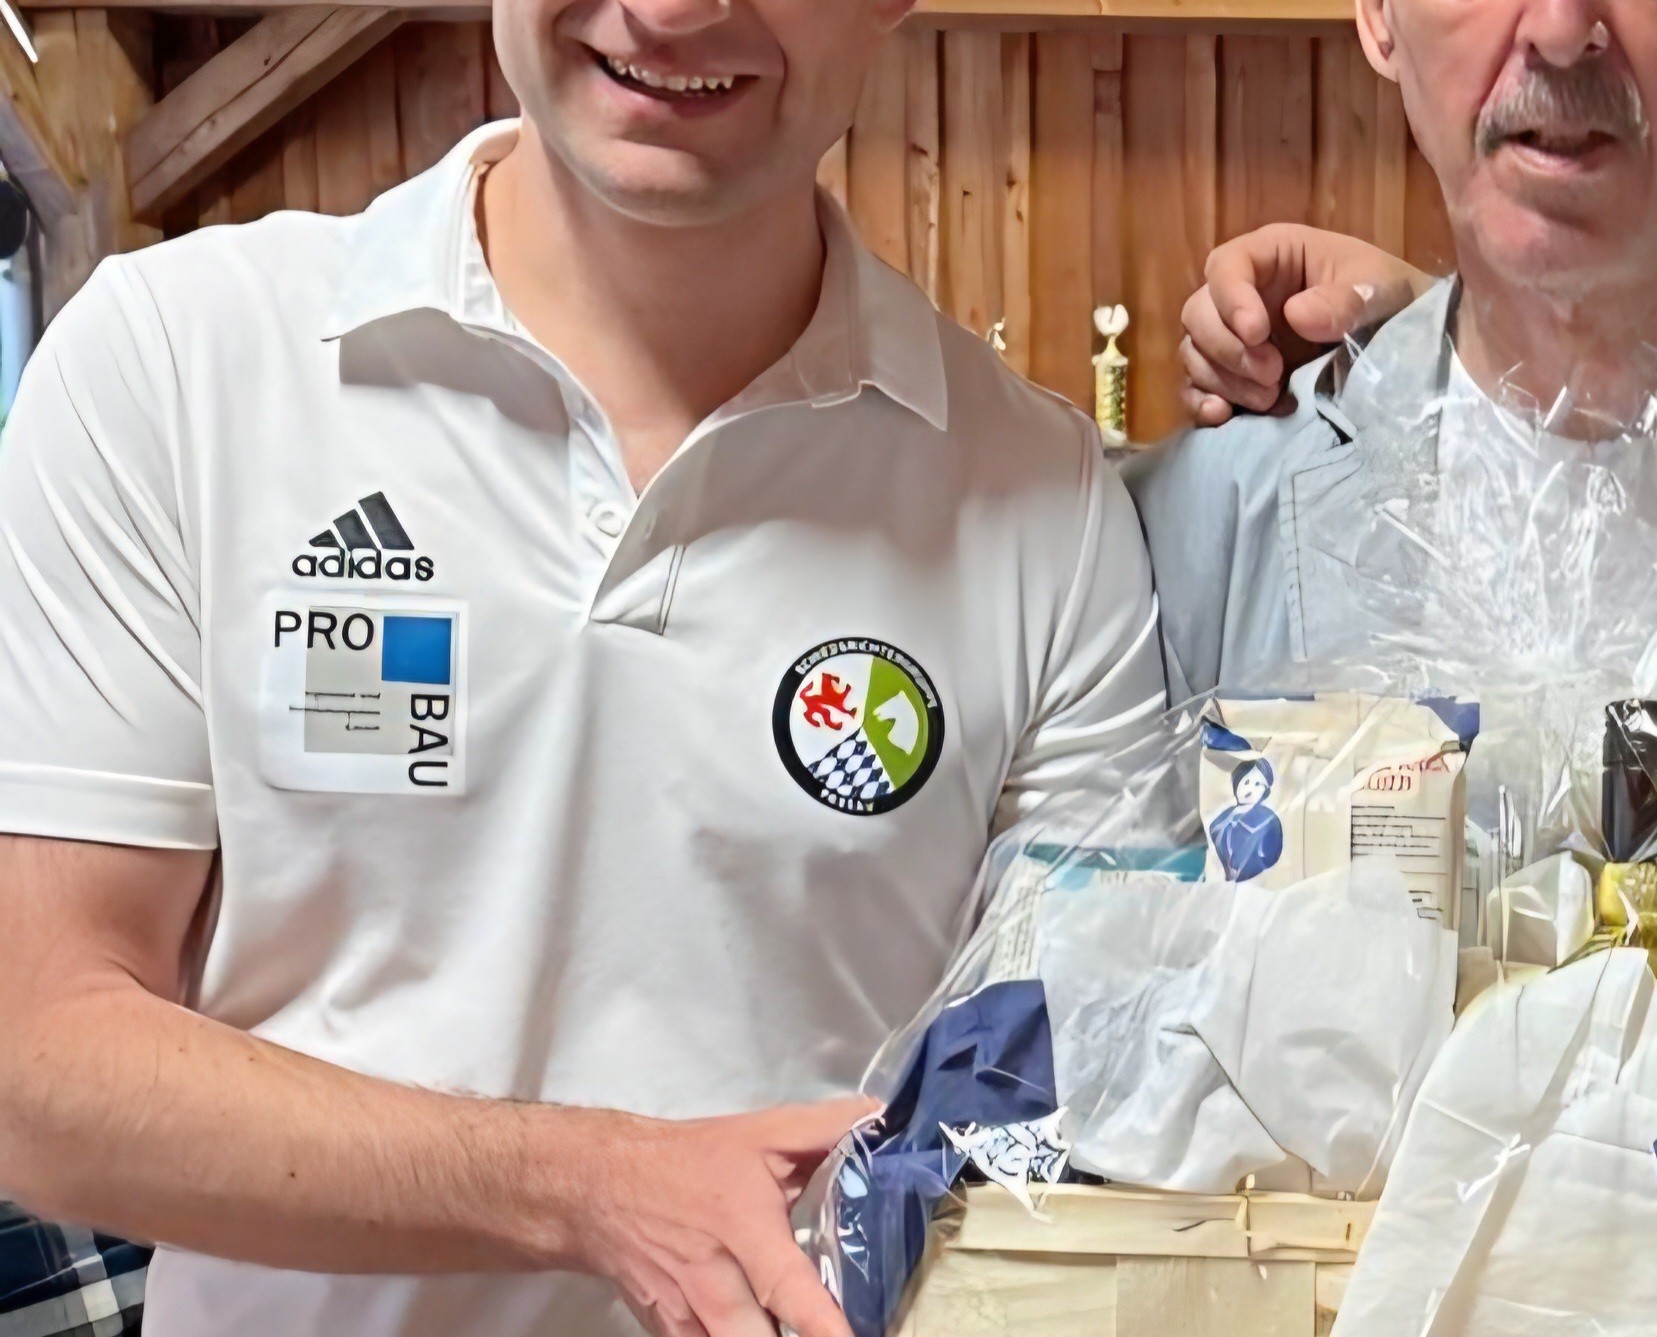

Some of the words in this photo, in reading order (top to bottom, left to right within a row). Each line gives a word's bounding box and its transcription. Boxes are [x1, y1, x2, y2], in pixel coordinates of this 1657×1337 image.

[292, 547, 435, 582] adidas
[274, 610, 375, 651] PRO
[408, 693, 450, 787] BAU
